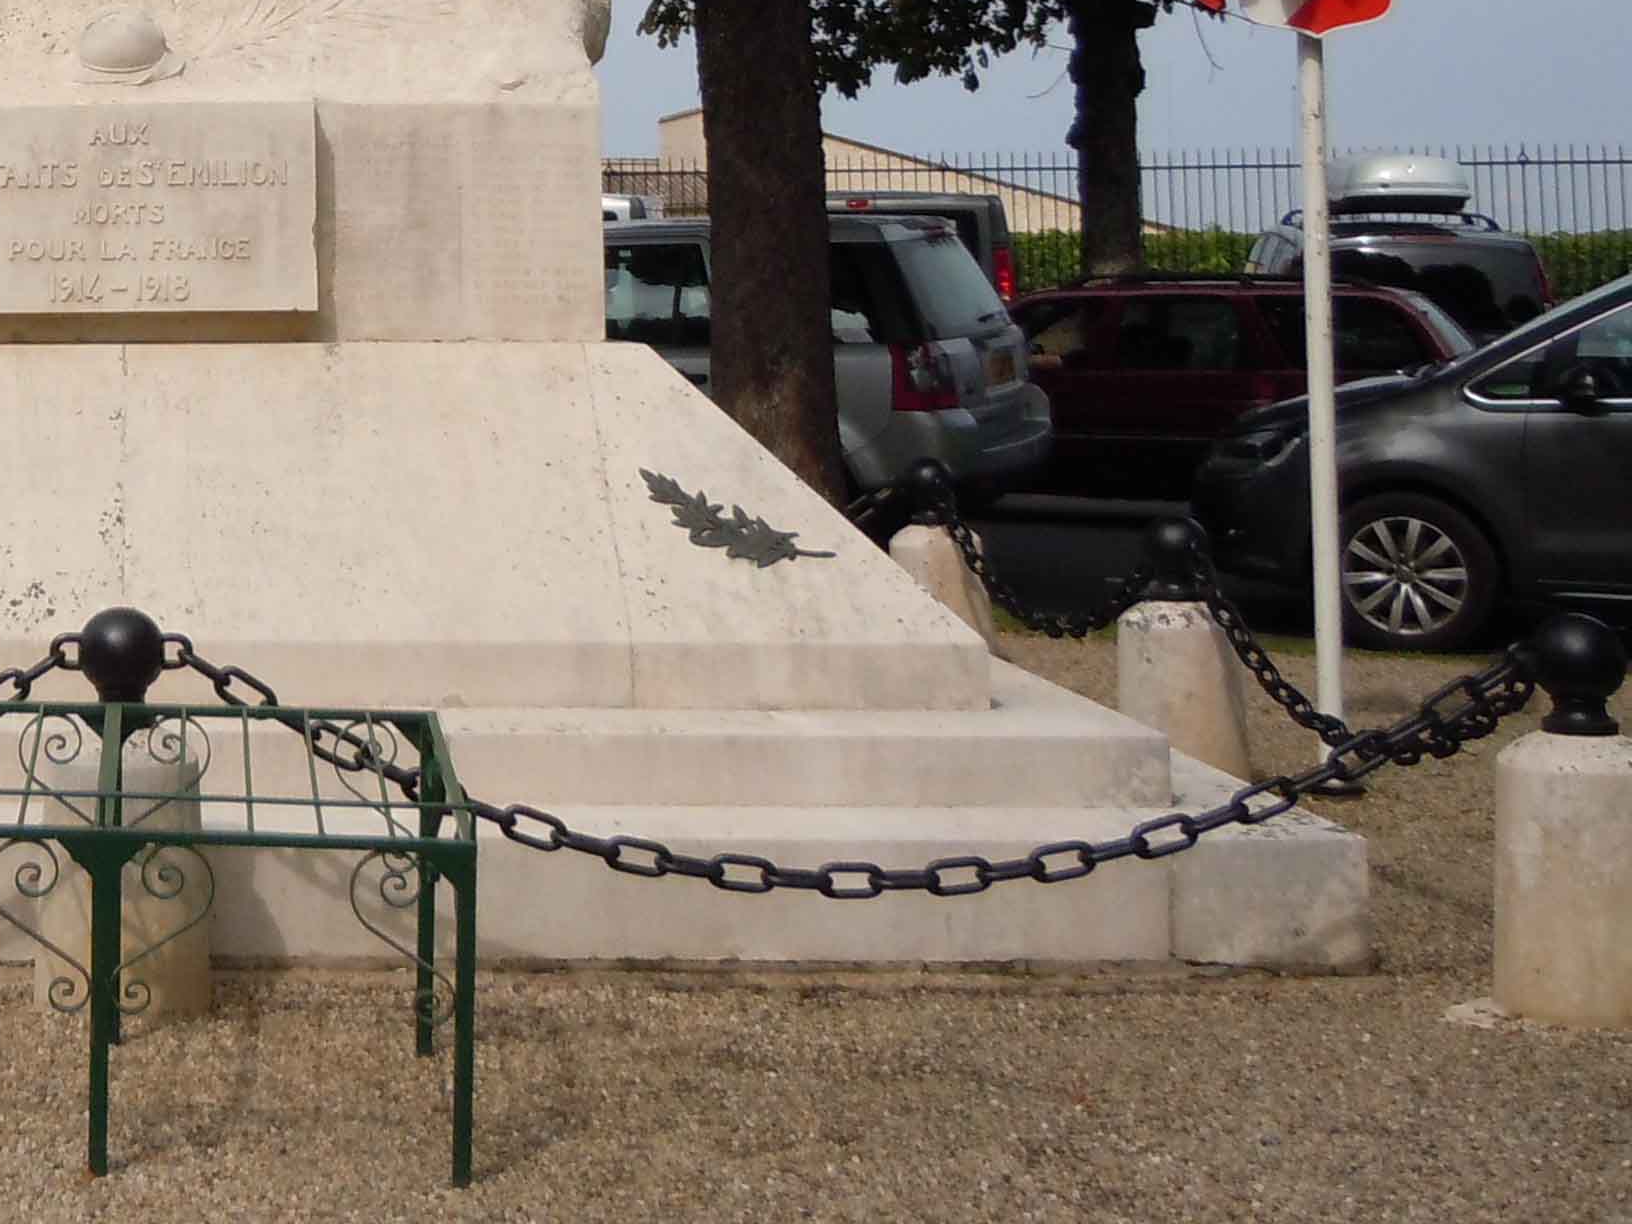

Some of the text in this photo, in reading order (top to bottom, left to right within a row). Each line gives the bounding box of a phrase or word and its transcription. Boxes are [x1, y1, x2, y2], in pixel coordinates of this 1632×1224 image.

[88, 122, 152, 146] AUX
[99, 169, 132, 188] DE
[167, 161, 289, 187] EMILION
[72, 202, 167, 225] MORTS
[8, 239, 252, 262] POUR LA FRANCE
